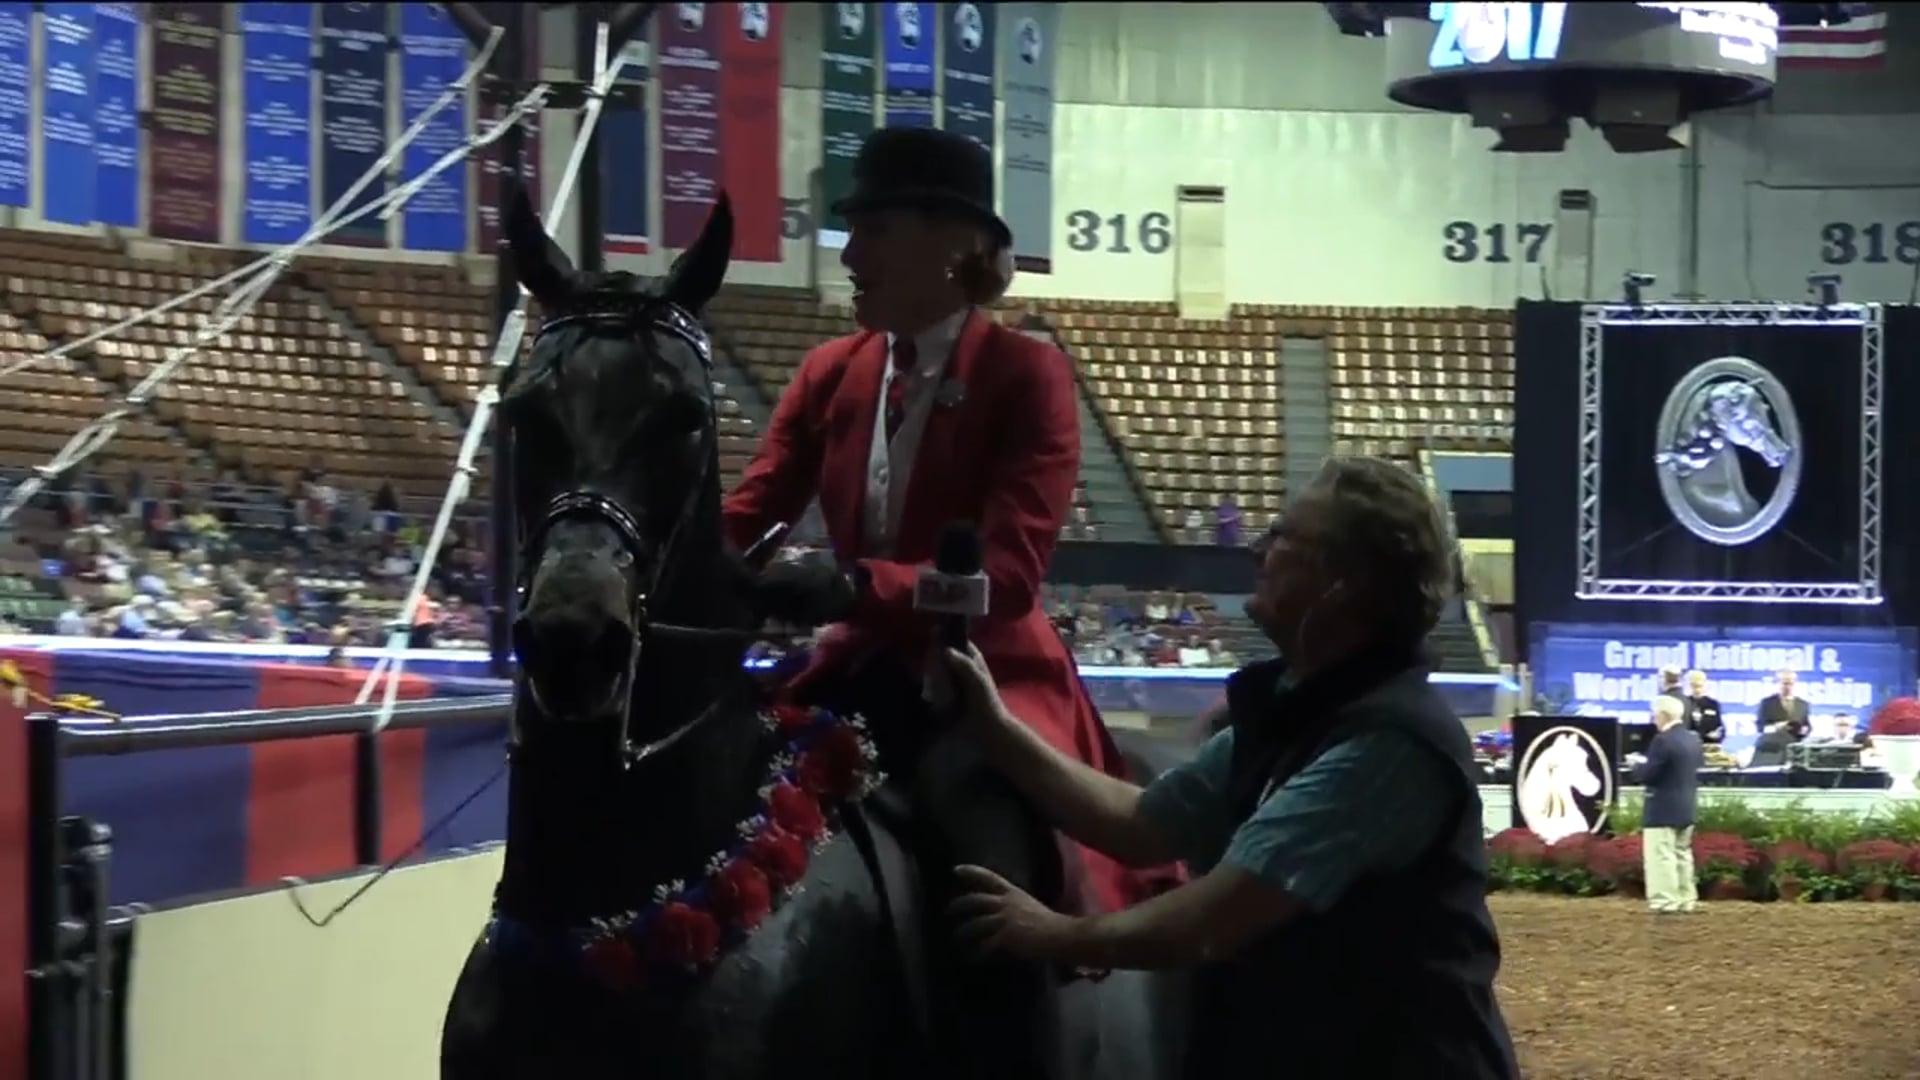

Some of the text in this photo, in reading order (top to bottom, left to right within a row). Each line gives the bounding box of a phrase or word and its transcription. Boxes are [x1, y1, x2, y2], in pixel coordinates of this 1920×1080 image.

[1066, 210, 1173, 254] 316
[1444, 221, 1553, 263] 317
[1822, 221, 1920, 265] 318
[1604, 640, 1842, 672] Grand National &
[1573, 671, 1658, 701] World
